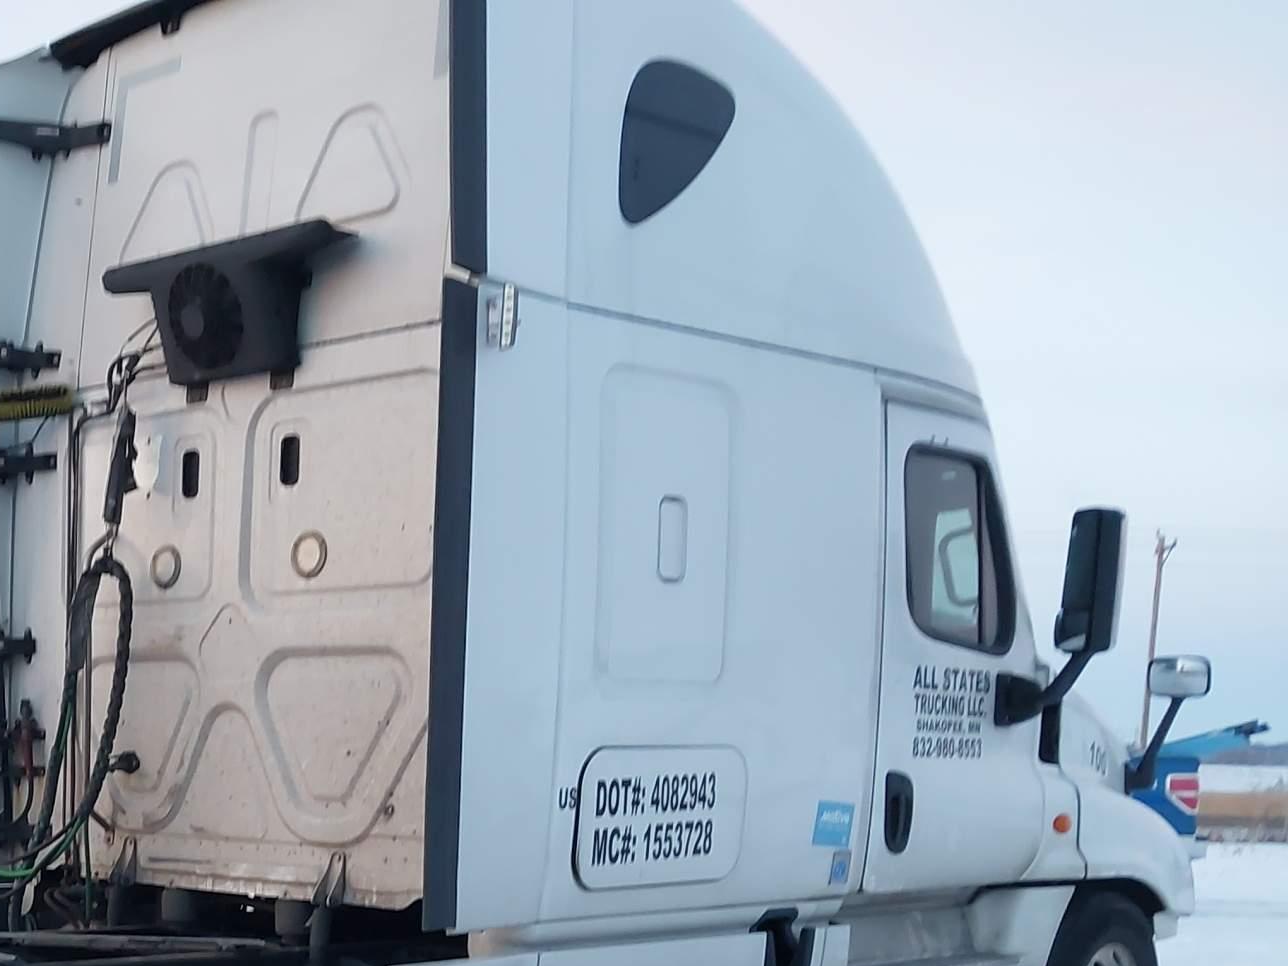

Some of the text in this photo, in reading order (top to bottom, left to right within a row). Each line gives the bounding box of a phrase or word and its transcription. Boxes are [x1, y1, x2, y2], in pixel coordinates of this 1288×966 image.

[913, 665, 991, 694] ALL STATES
[914, 694, 965, 716] TRUCKING
[913, 736, 982, 758] 832-980-8553
[559, 771, 716, 817] US DOT#: 4082943
[591, 818, 713, 866] MC#: 1553728
